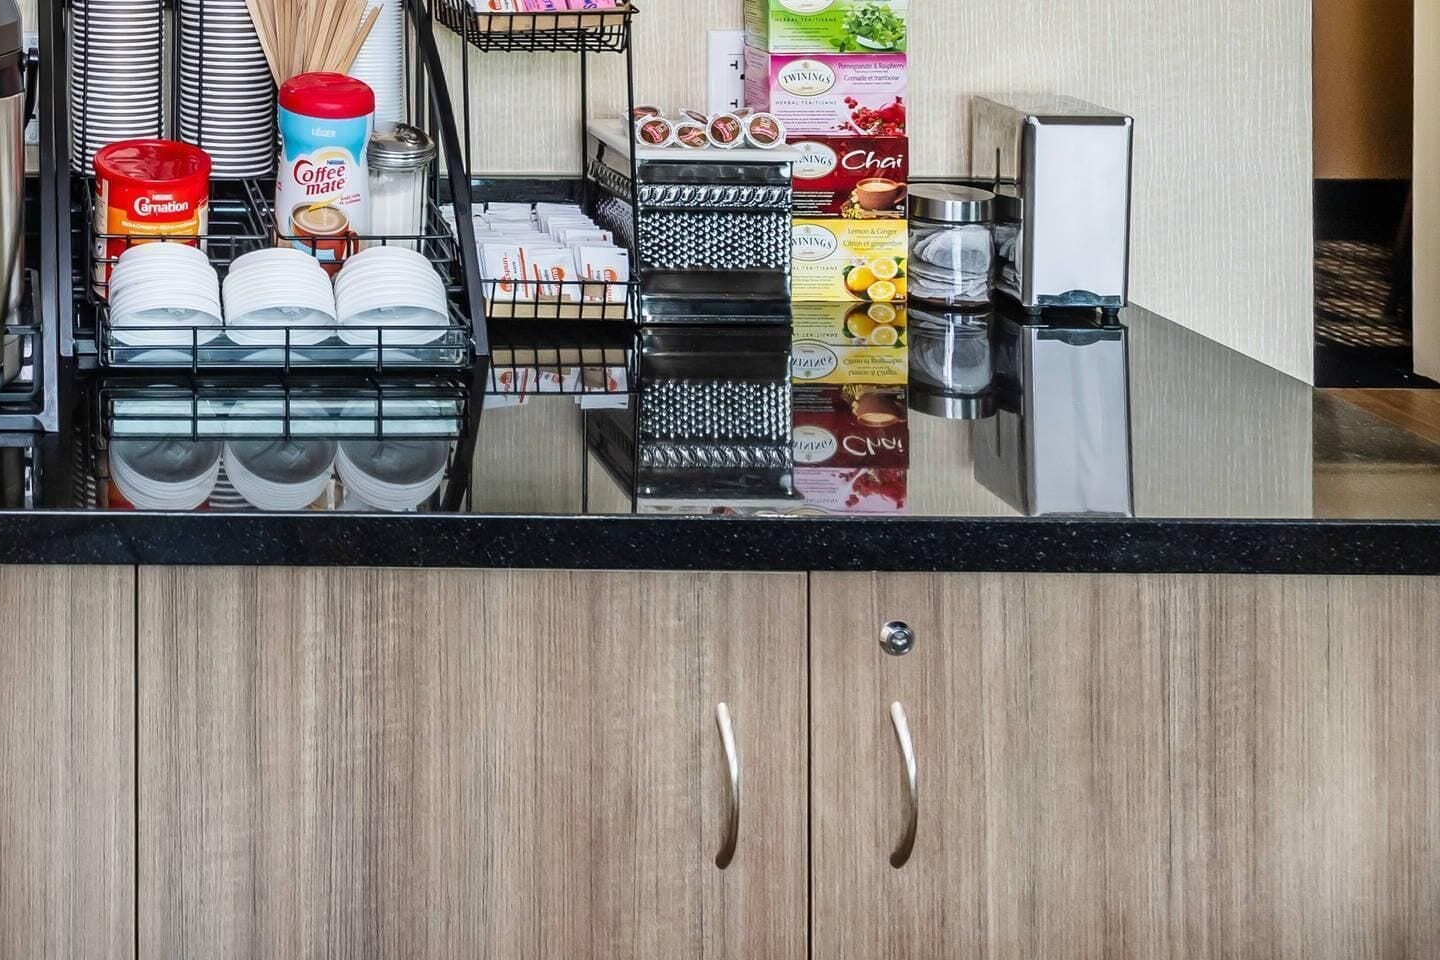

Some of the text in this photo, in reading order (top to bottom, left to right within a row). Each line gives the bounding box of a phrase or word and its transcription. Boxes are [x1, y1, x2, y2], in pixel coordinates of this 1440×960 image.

[783, 72, 831, 84] TWININGS
[841, 149, 903, 170] Chai
[293, 159, 345, 186] Coffee
[305, 177, 345, 196] mate
[134, 196, 189, 217] Carnation
